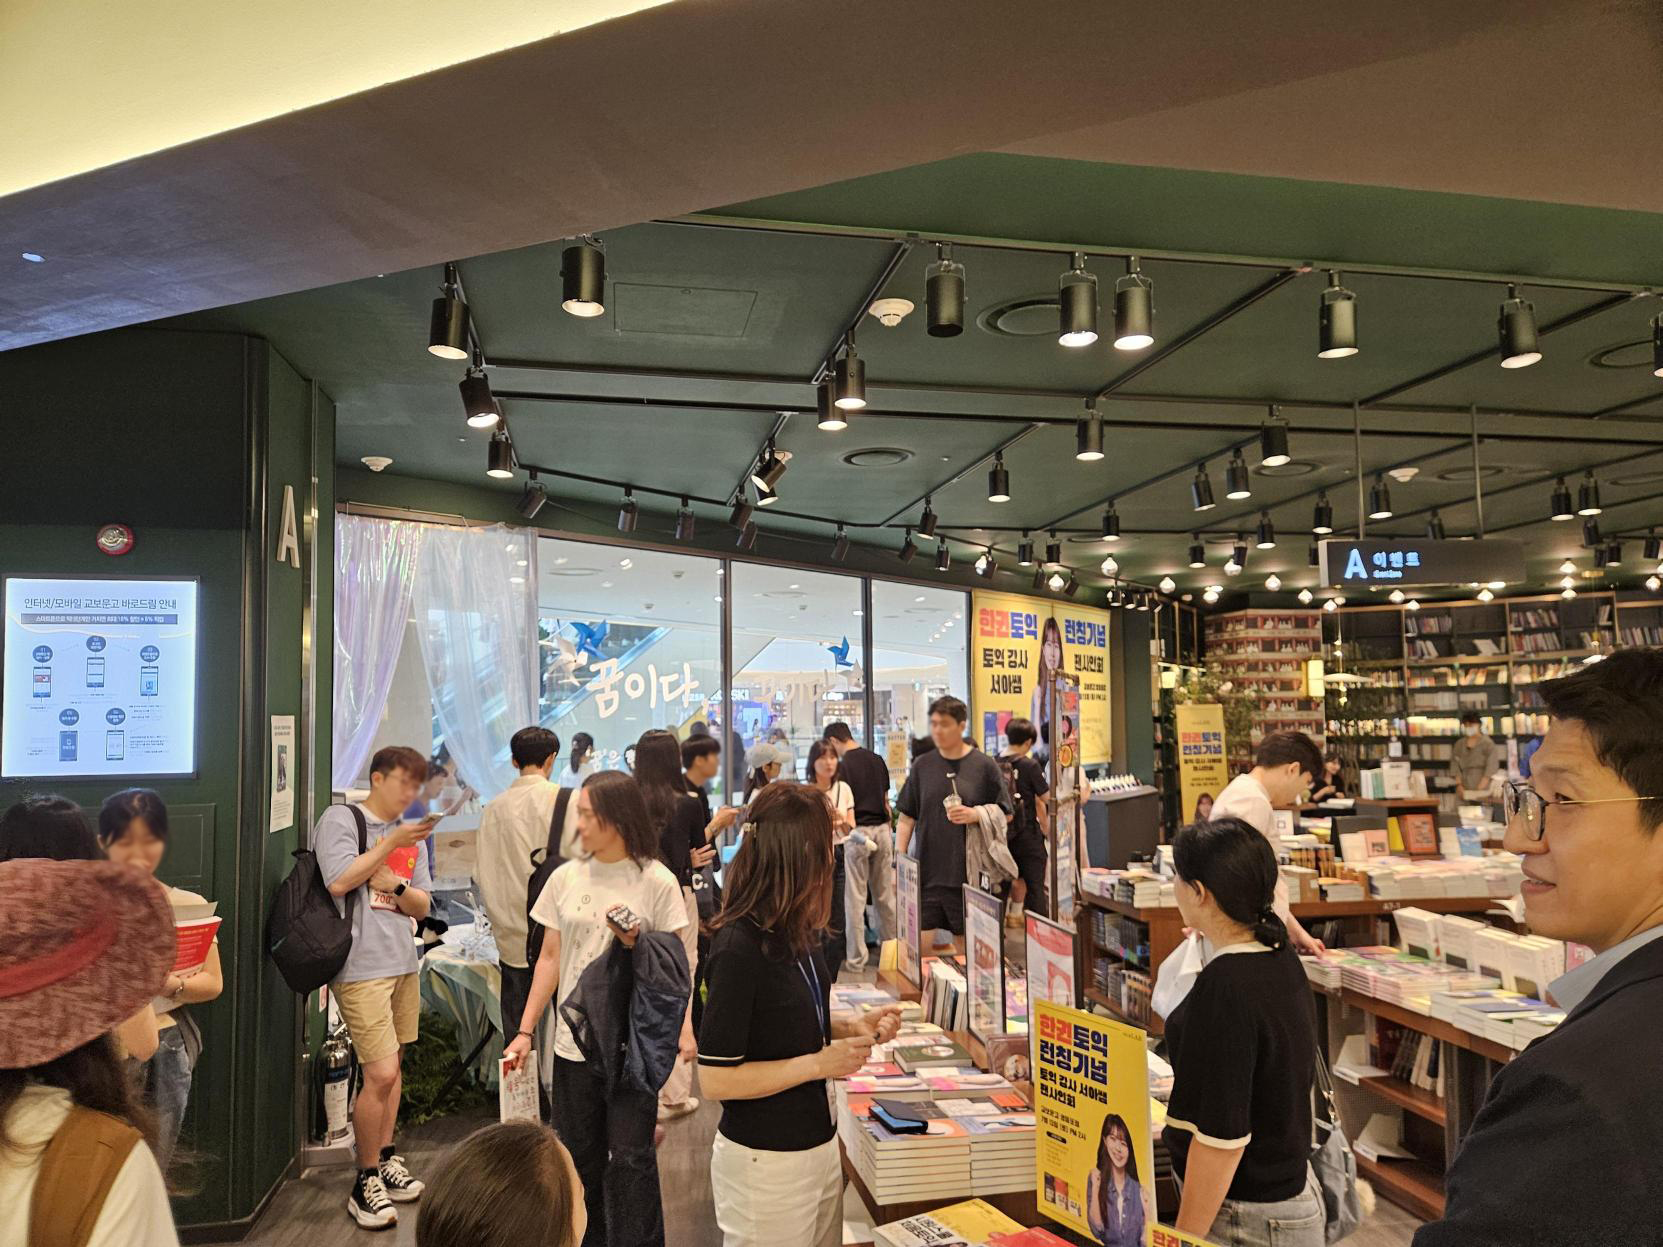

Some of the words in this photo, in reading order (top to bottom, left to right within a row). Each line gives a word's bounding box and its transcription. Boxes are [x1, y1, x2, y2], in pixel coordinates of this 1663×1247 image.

[277, 485, 300, 568] A
[1344, 548, 1368, 579] A
[1372, 551, 1420, 568] 이벤트
[24, 598, 82, 609] 인터넷/모바일
[84, 599, 119, 609] 교보문고
[121, 599, 157, 609] 바로드림
[158, 599, 177, 609] 안내
[979, 607, 1038, 640] 한권토익
[1065, 619, 1105, 648] 런칭기념
[983, 648, 1005, 668] 토익
[1007, 649, 1028, 669] 강사
[1040, 1014, 1108, 1058] 한권토익
[1040, 1039, 1108, 1085] 런칭기념
[1040, 1067, 1057, 1084] 토익
[1059, 1074, 1077, 1093] 강사
[1040, 1083, 1076, 1108] 팬사인회
